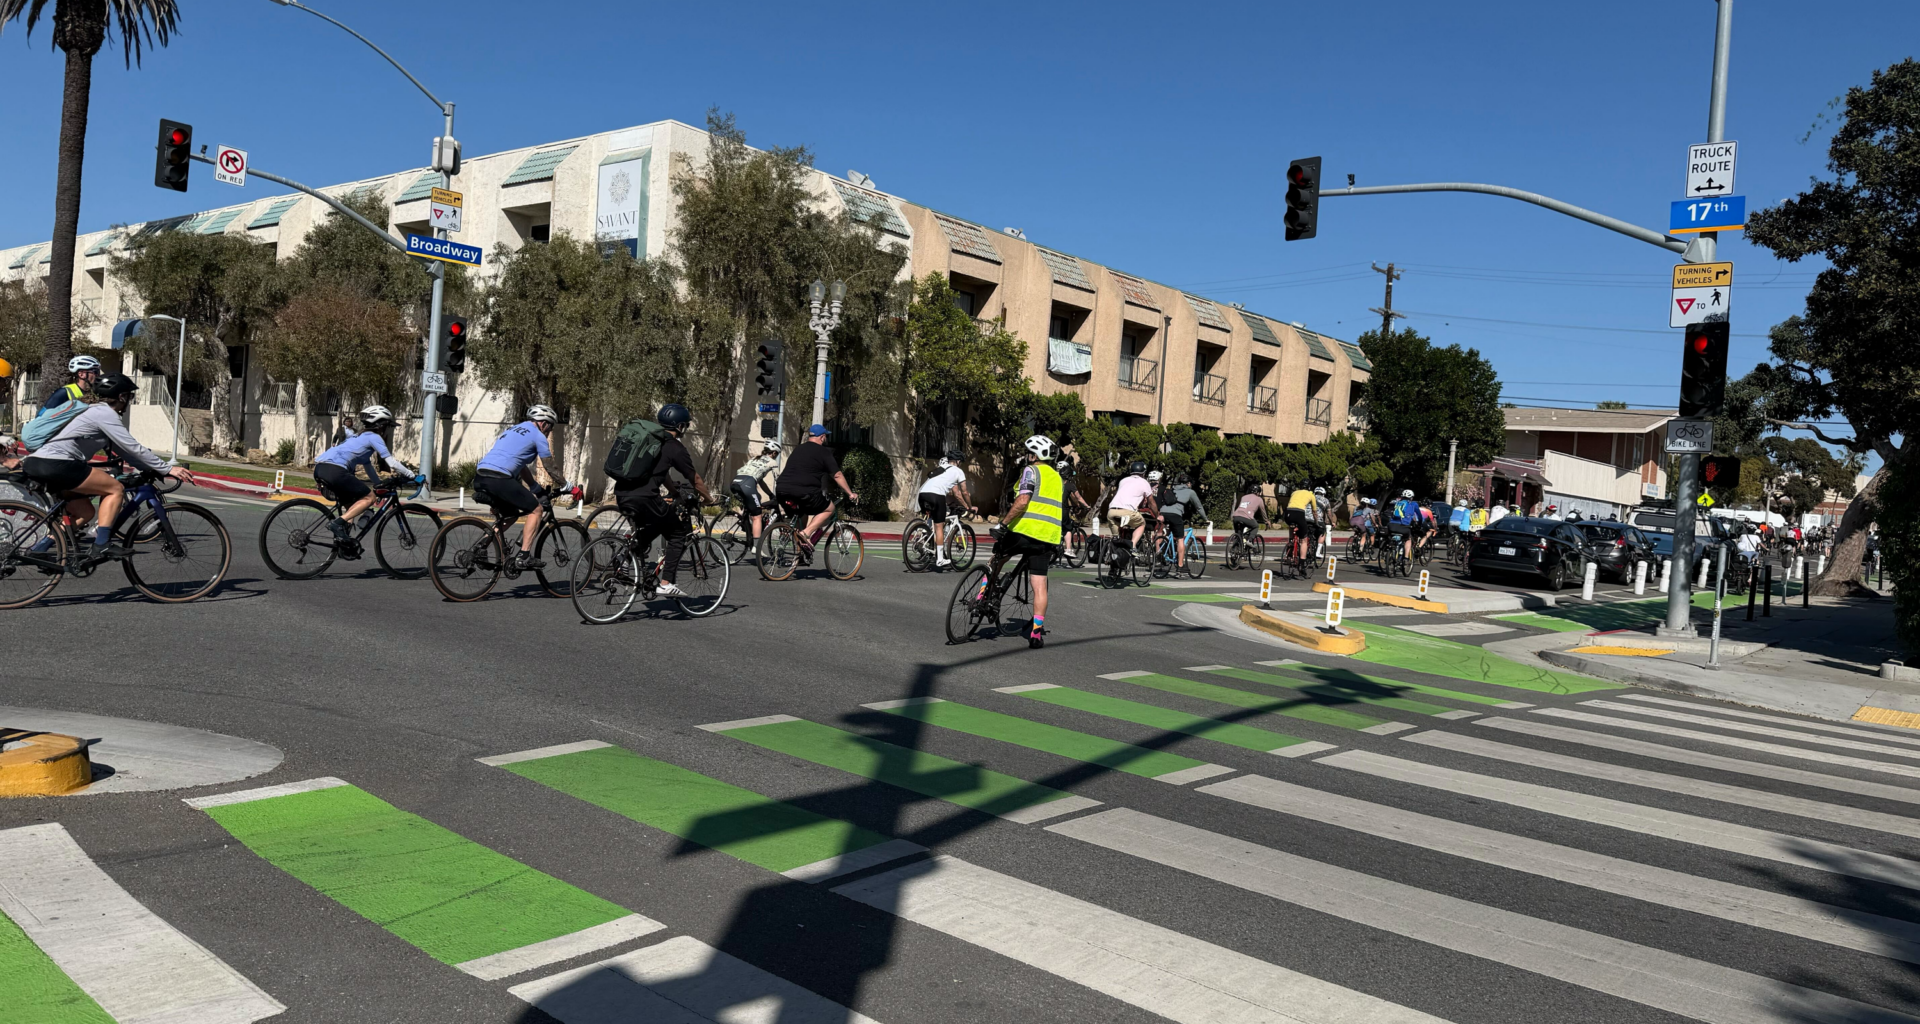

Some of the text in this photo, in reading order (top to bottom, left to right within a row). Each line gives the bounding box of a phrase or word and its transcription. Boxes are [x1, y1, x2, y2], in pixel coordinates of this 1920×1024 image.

[1693, 146, 1732, 159] TRUCK
[1692, 161, 1731, 174] ROUTE
[217, 172, 243, 184] ON RED
[1687, 202, 1729, 221] 17th
[598, 210, 638, 229] SAVANT
[410, 236, 479, 262] Broadway
[1678, 267, 1712, 275] TURNING
[1676, 276, 1713, 285] VEHICLES
[1696, 302, 1706, 310] TO
[1671, 440, 1687, 448] BIKE
